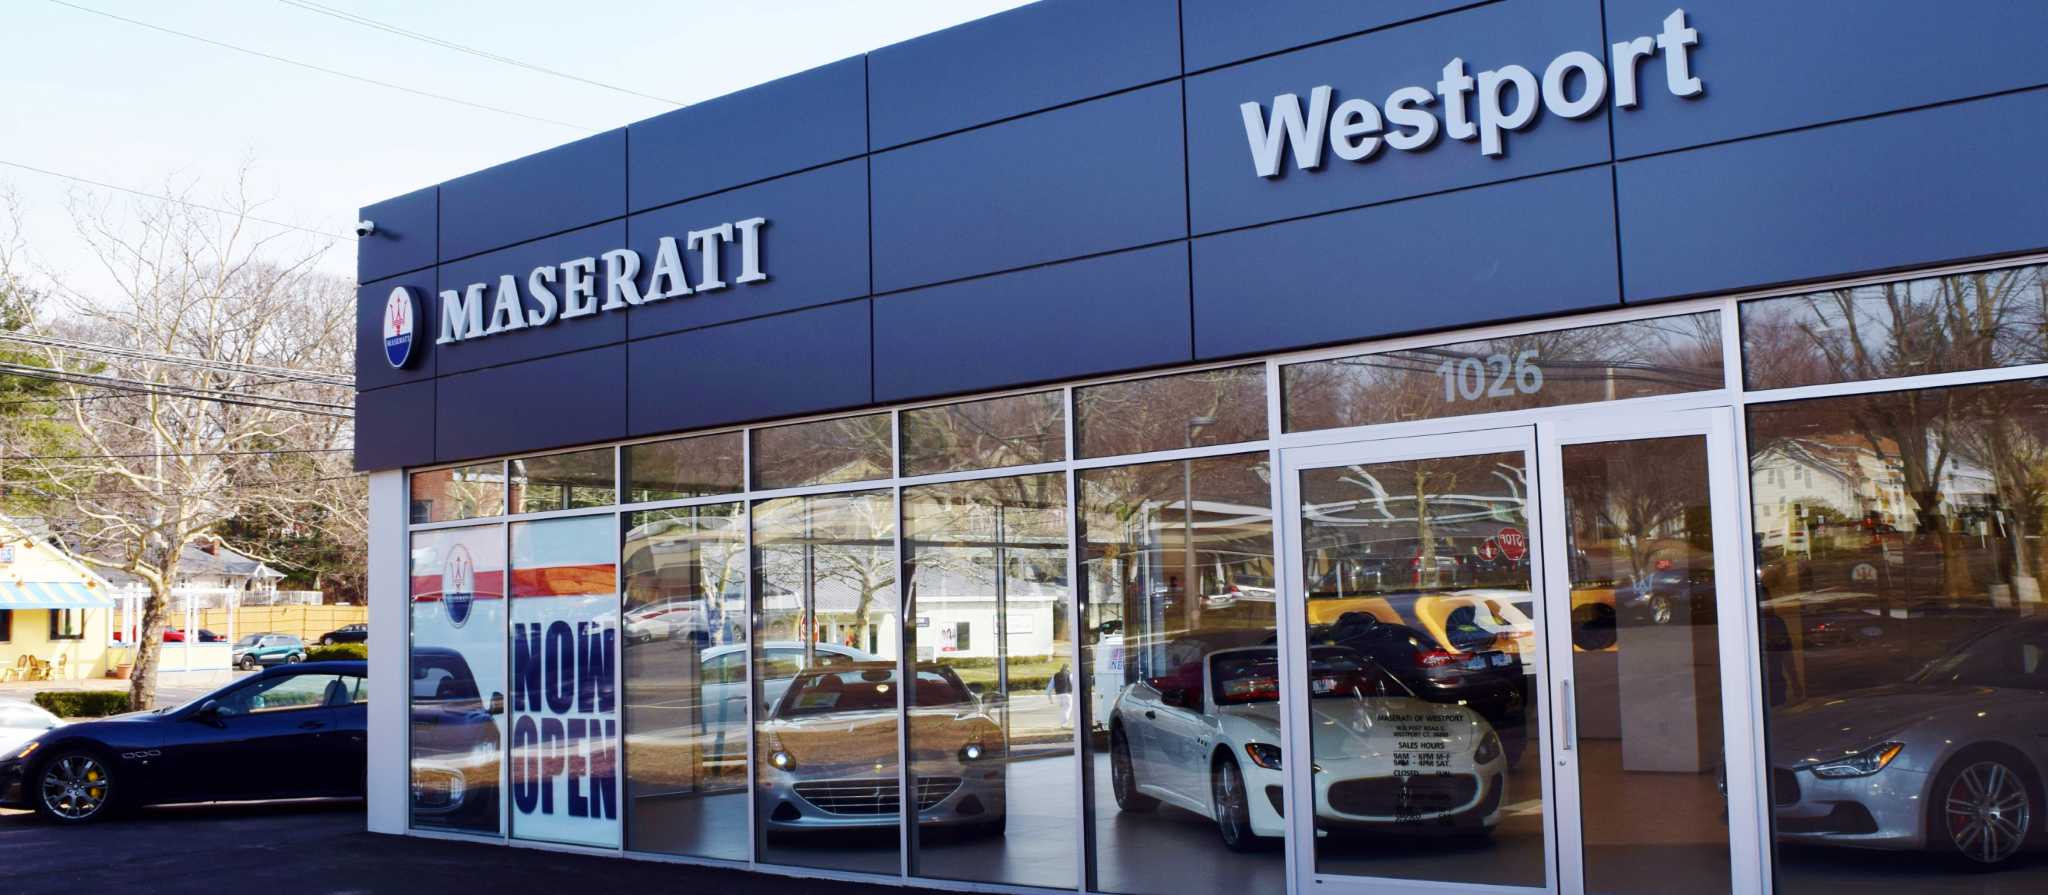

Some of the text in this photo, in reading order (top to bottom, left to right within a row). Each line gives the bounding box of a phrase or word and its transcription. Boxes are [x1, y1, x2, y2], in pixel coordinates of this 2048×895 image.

[1240, 8, 1704, 177] Westport
[436, 217, 768, 345] MASERATI
[1435, 349, 1544, 402] 1026
[514, 620, 616, 714] NOW
[1377, 714, 1412, 722] MASERATI
[1398, 742, 1445, 750] SALES HOURS
[514, 715, 618, 820] OPEN
[1393, 769, 1420, 777] CLOSED
